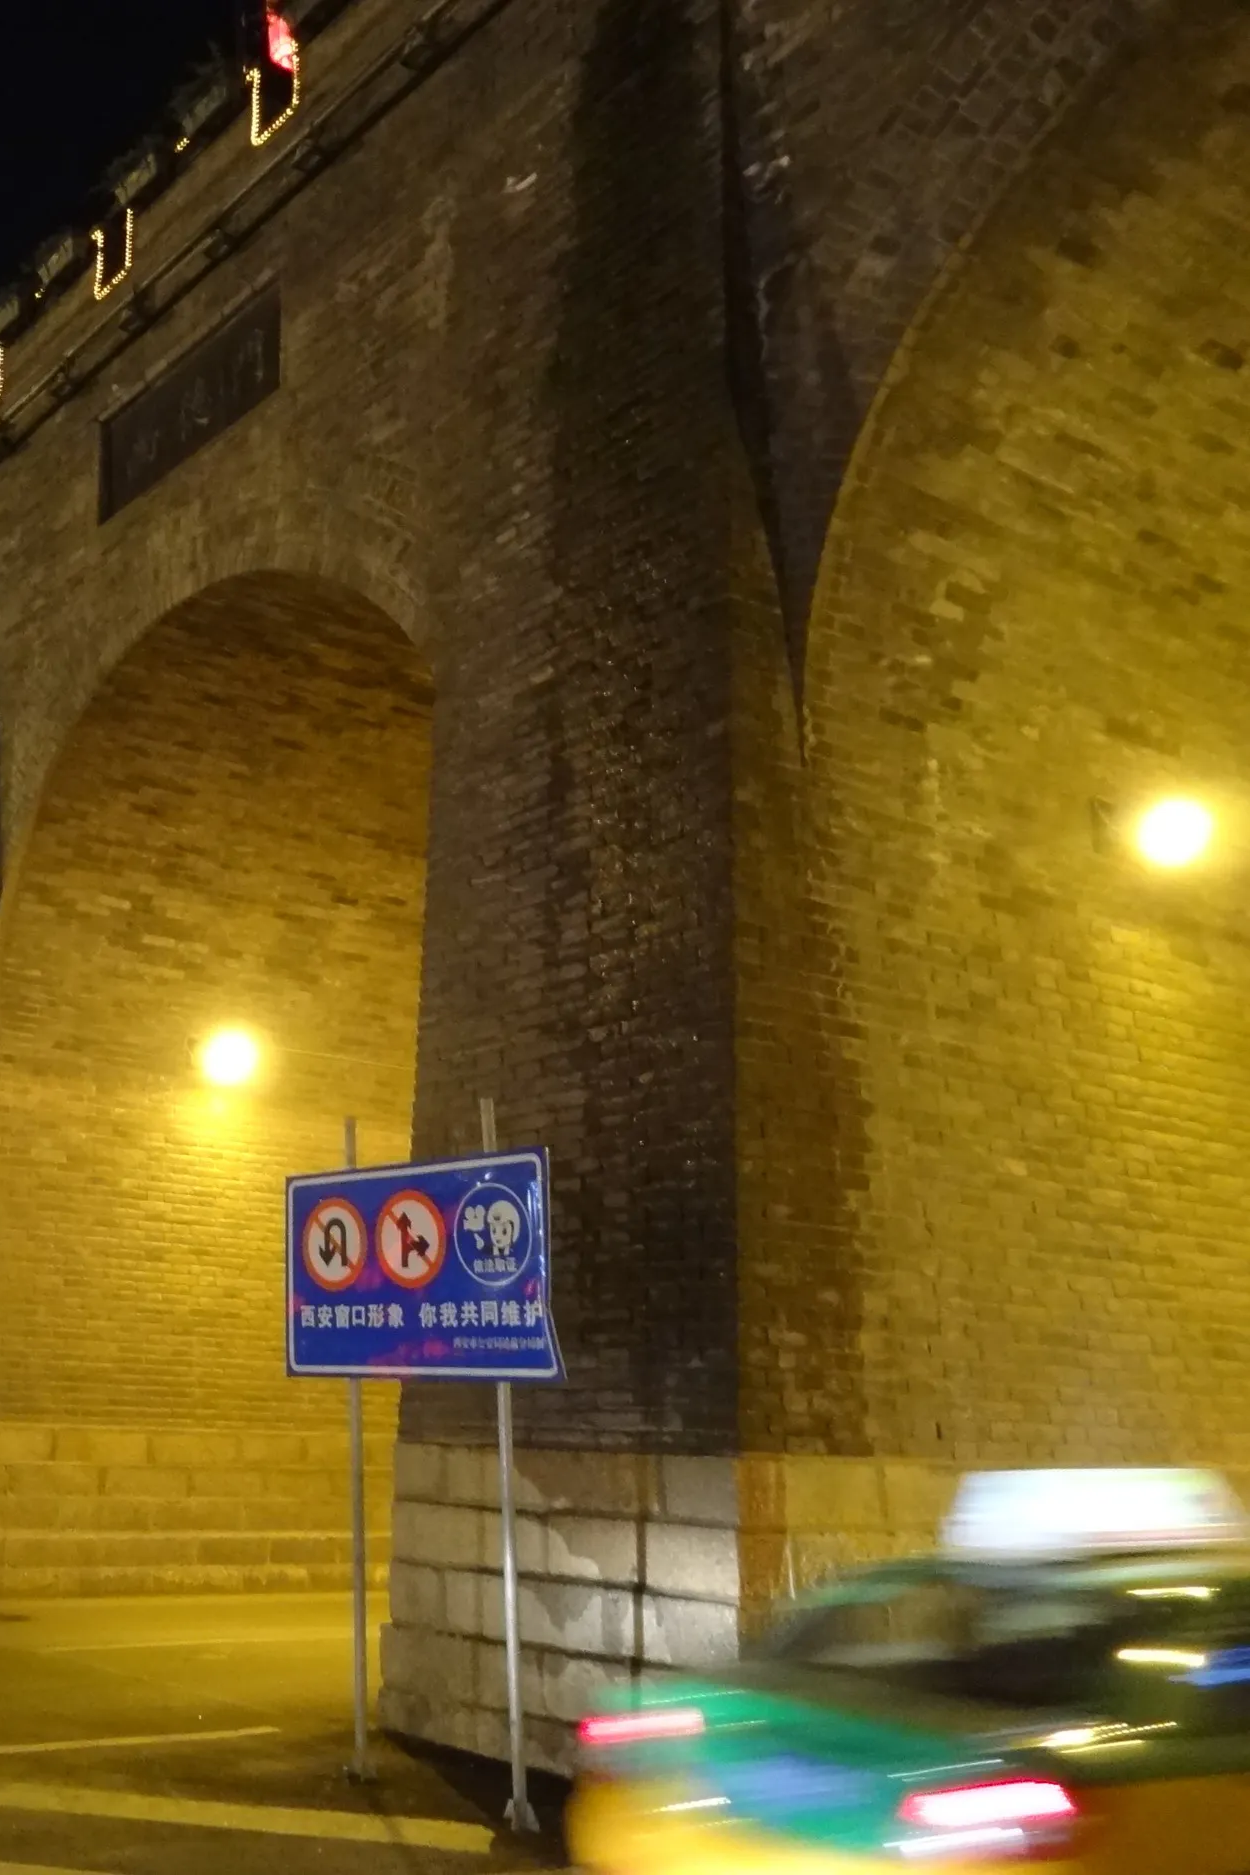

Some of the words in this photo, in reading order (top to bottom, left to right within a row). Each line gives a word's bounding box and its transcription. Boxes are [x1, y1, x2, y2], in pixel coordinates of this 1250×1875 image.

[301, 1303, 405, 1329] 西安窗口形象
[419, 1300, 544, 1328] 你我共同维护
